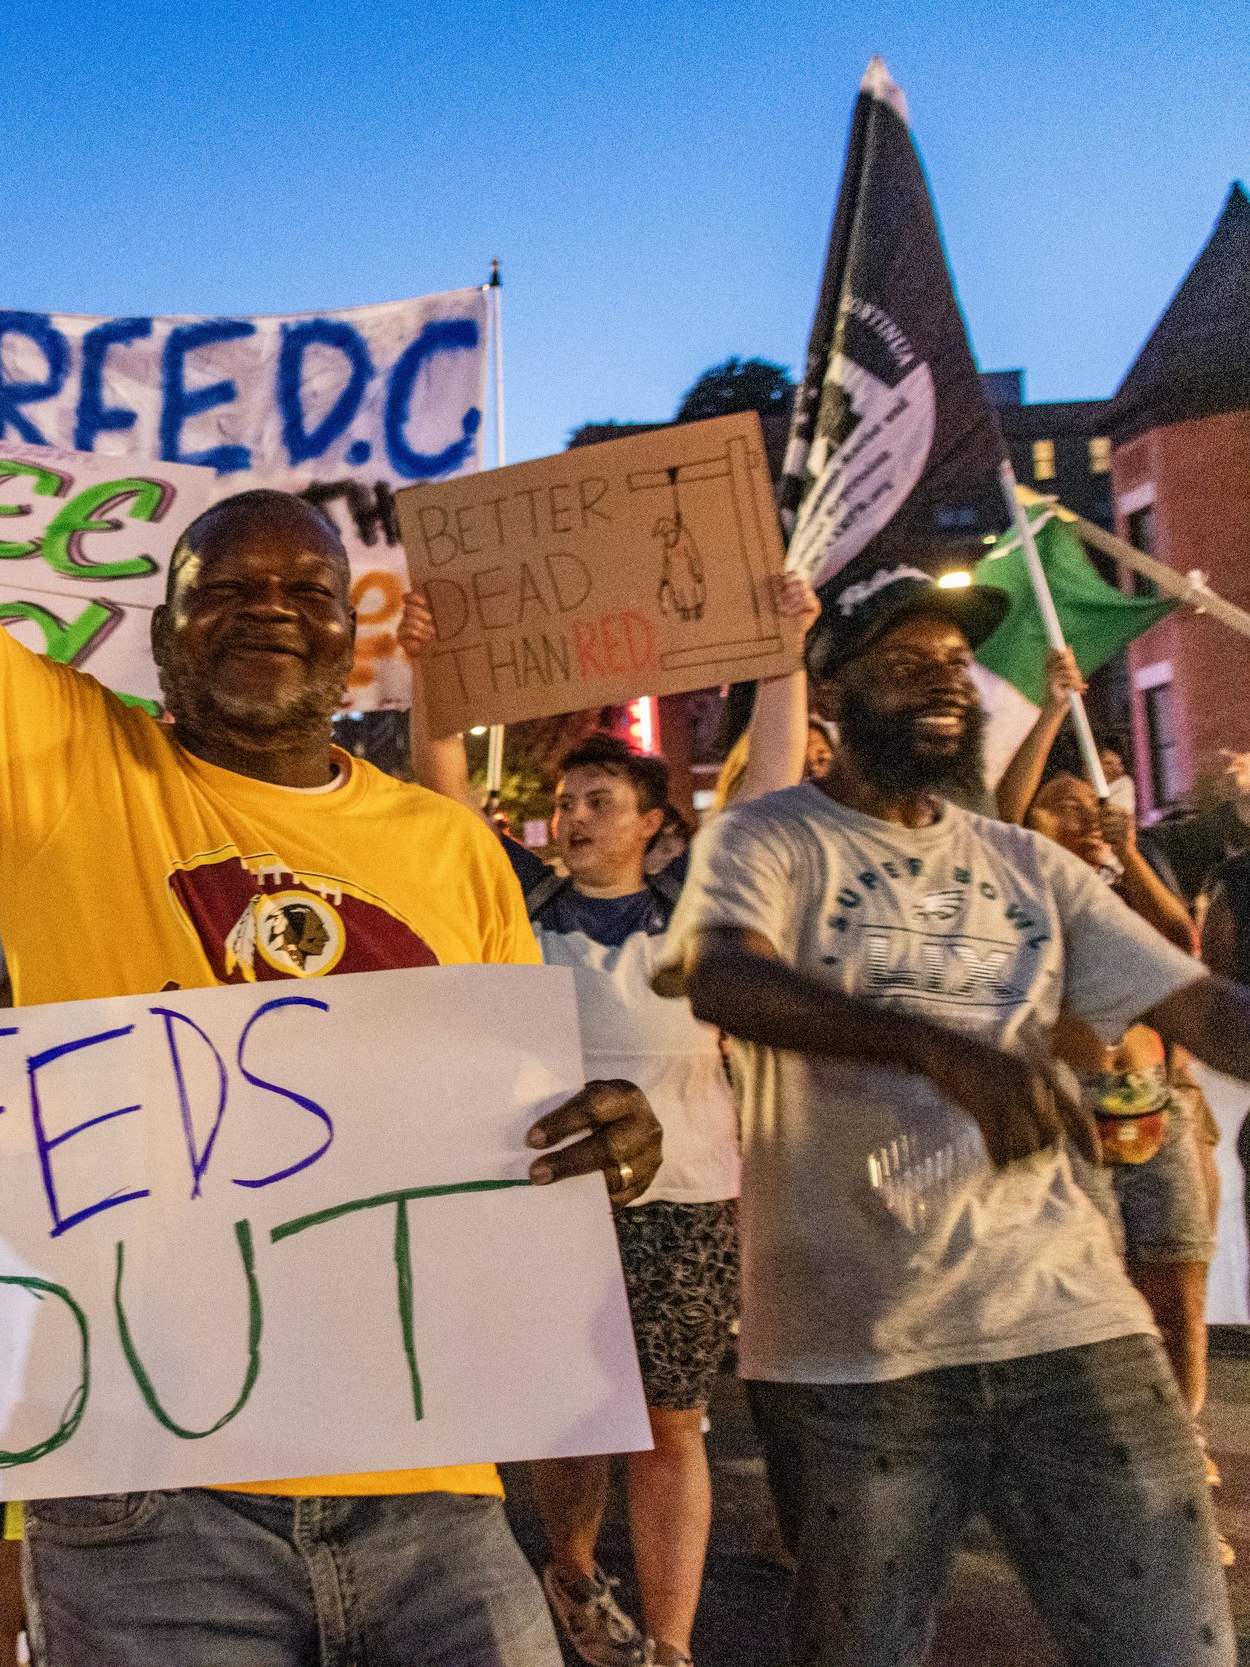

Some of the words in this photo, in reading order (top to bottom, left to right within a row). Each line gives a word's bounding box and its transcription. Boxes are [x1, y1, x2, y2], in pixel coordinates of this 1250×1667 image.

[418, 476, 612, 568] BETTER
[424, 552, 594, 643] DEAD
[432, 634, 571, 699] THAN
[573, 607, 656, 678] RED
[953, 866, 1052, 950] BOWL
[866, 935, 1025, 998] LIX
